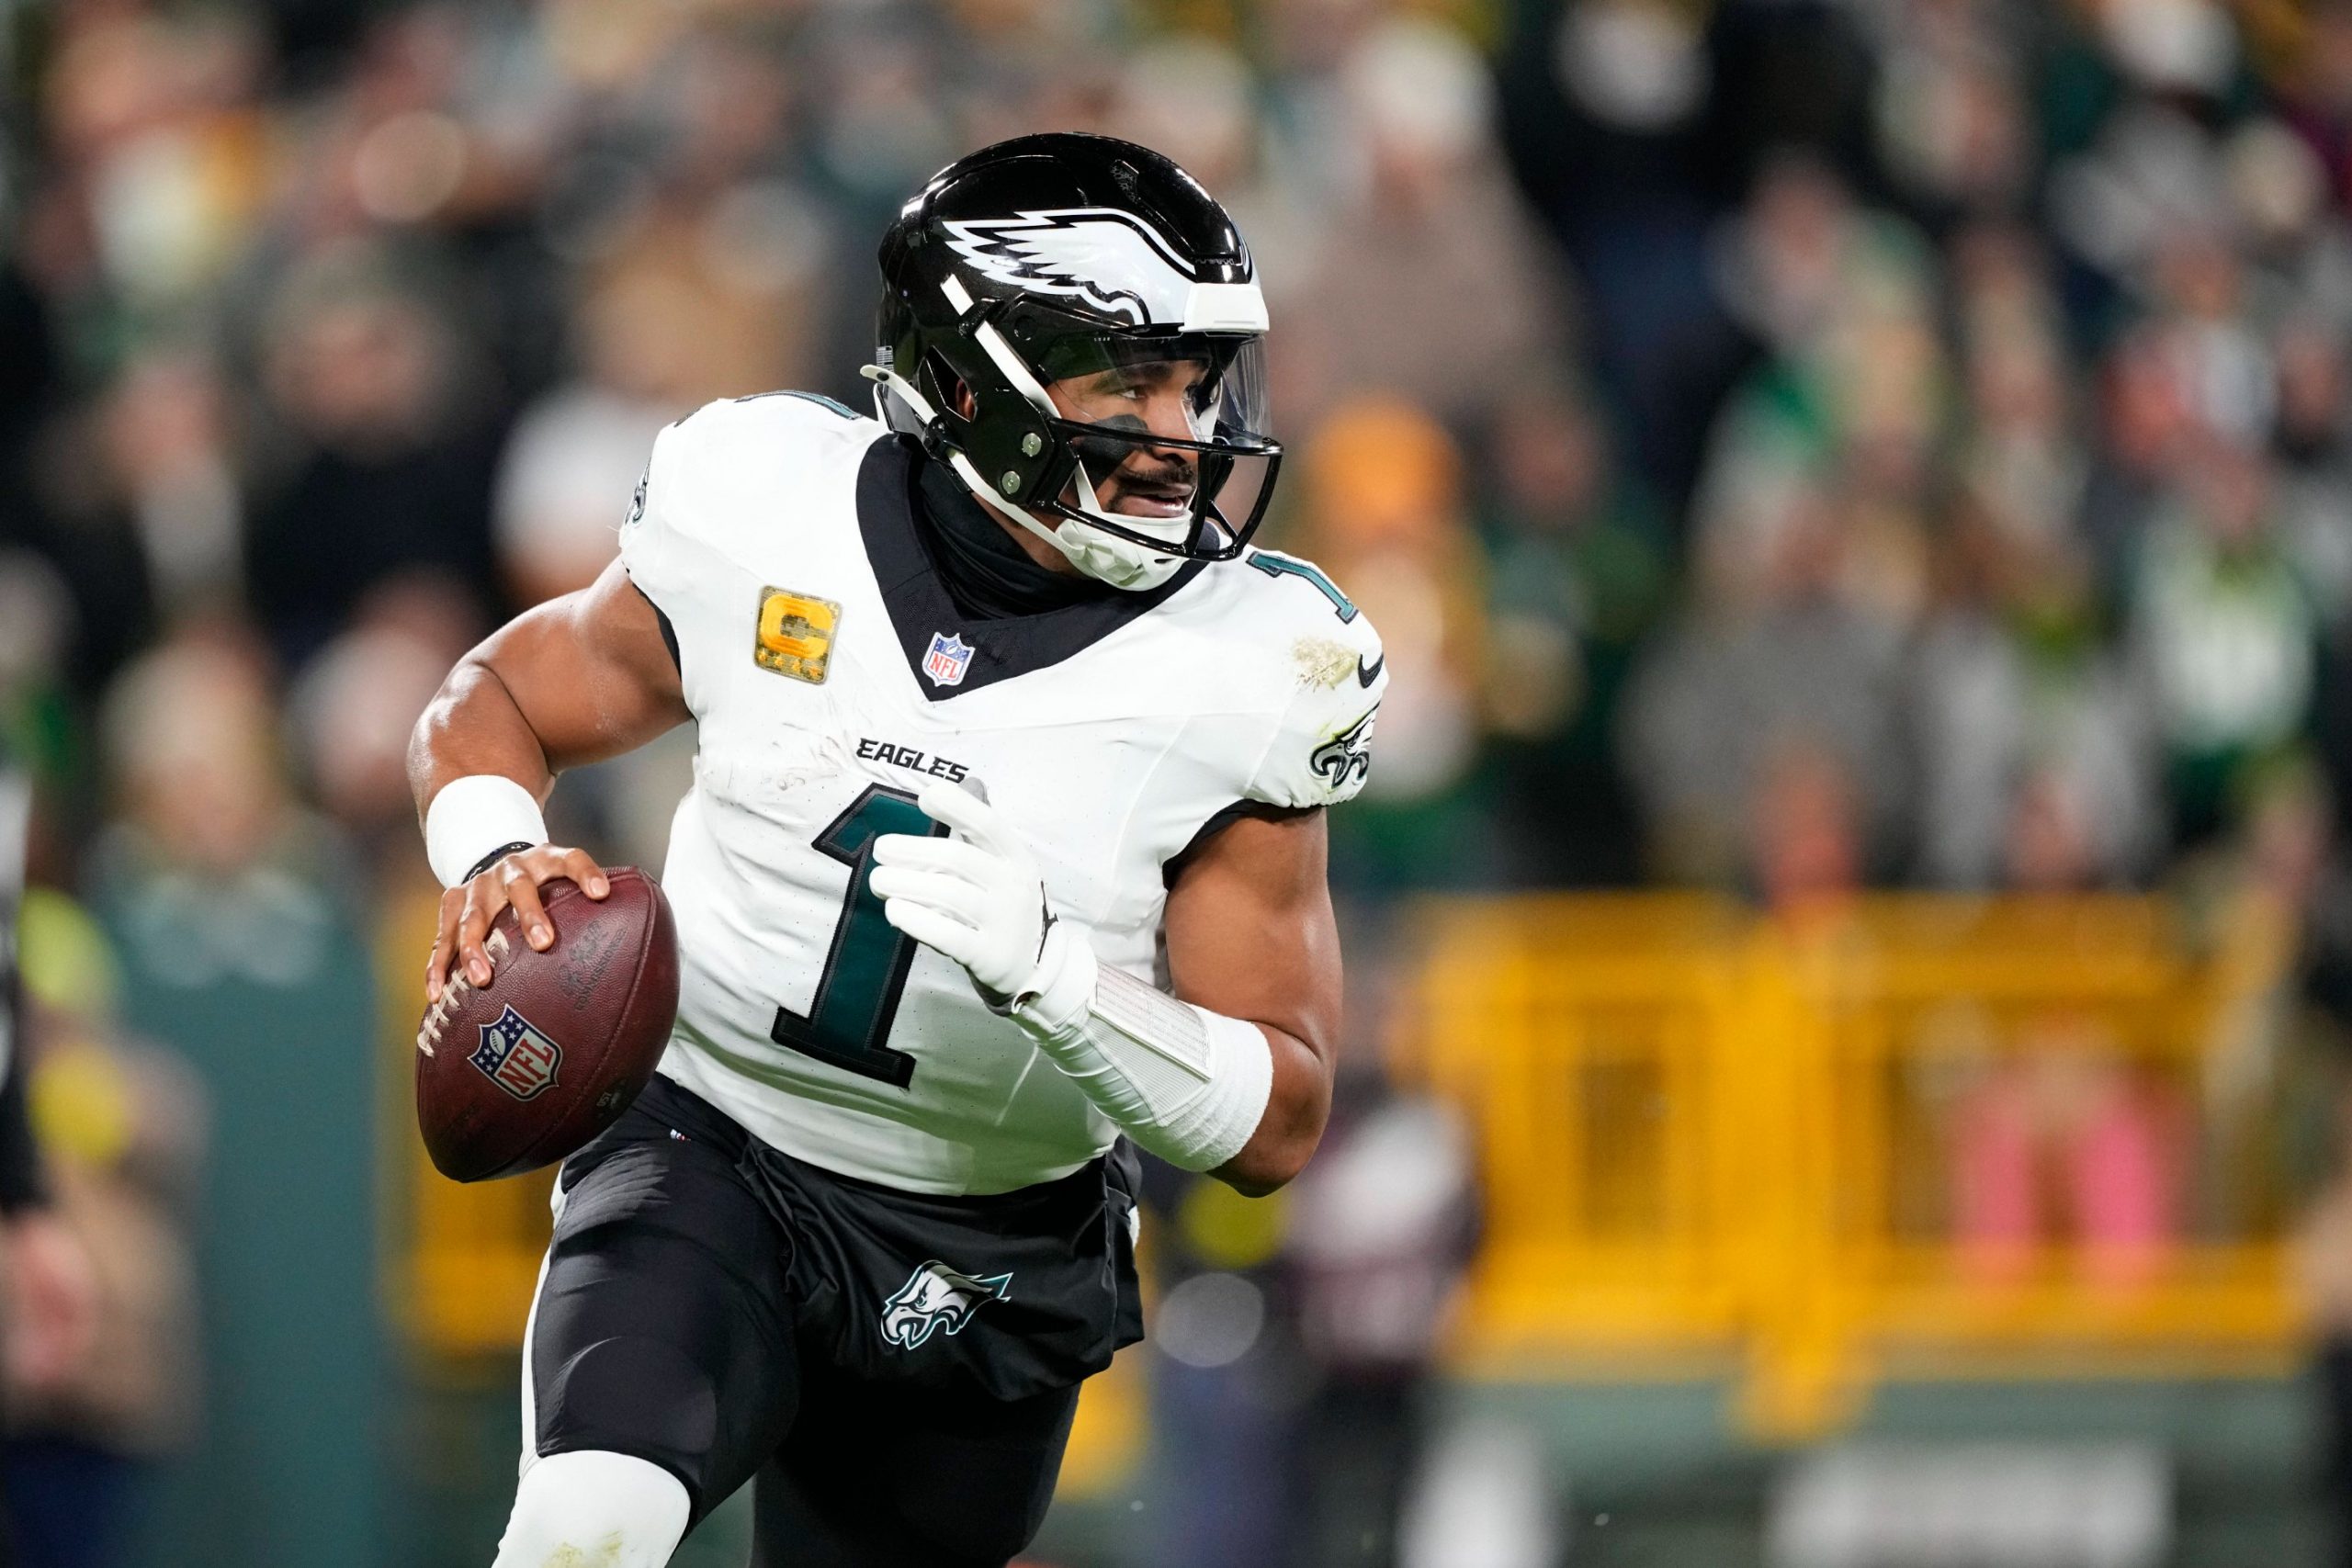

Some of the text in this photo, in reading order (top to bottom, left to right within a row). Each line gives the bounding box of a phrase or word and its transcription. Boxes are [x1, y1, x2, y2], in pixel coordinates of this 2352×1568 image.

[1246, 550, 1359, 625] 1
[759, 593, 834, 660] C
[929, 652, 958, 679] NFL
[855, 738, 970, 784] EAGLES
[770, 781, 952, 1089] 1
[496, 1037, 555, 1095] NFL
